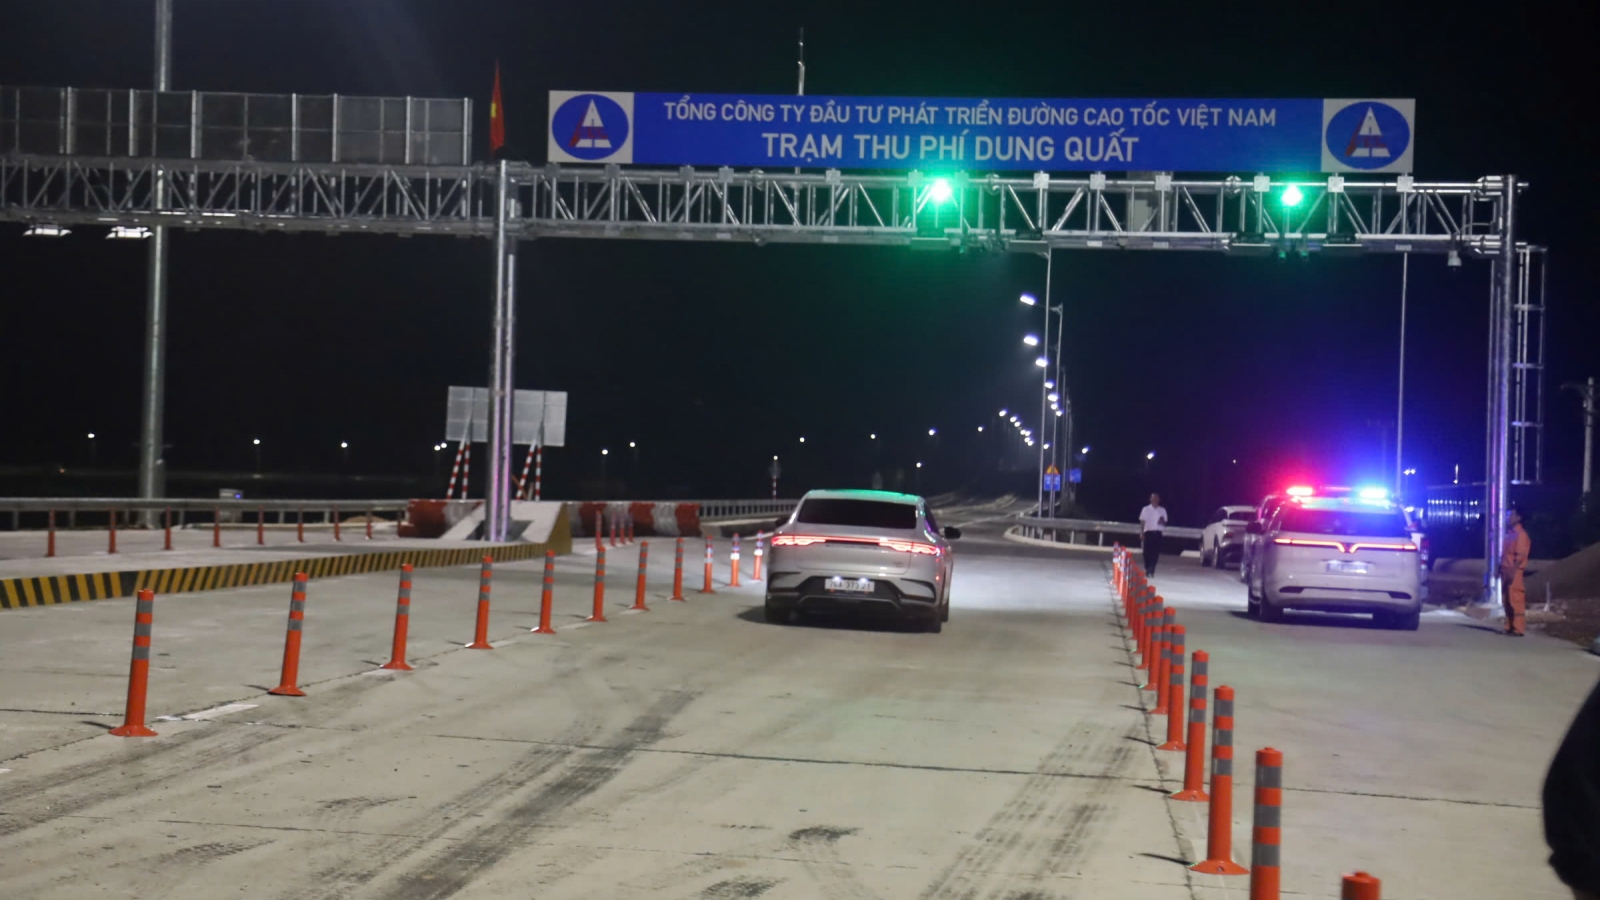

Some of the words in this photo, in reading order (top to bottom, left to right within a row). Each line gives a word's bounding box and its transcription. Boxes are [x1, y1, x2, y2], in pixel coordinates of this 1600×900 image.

[664, 95, 716, 120] TỔNG
[720, 100, 775, 122] CÔNG
[780, 105, 806, 122] TY
[810, 98, 850, 123] ĐẦU
[855, 105, 885, 123] TƯ
[888, 101, 939, 124] PHÁT
[945, 97, 1002, 125] TRIỂN
[1007, 101, 1078, 125] ĐƯỜNG
[1084, 108, 1124, 126] CAO
[1130, 101, 1170, 126] TỐC
[1177, 105, 1223, 129] VIỆT
[1229, 108, 1276, 126] NAM
[762, 133, 844, 162] TRẠM
[853, 135, 910, 159] THU
[919, 128, 968, 160] PHÍ
[975, 136, 1056, 162] DUNG
[1065, 129, 1139, 163] QUẤT
